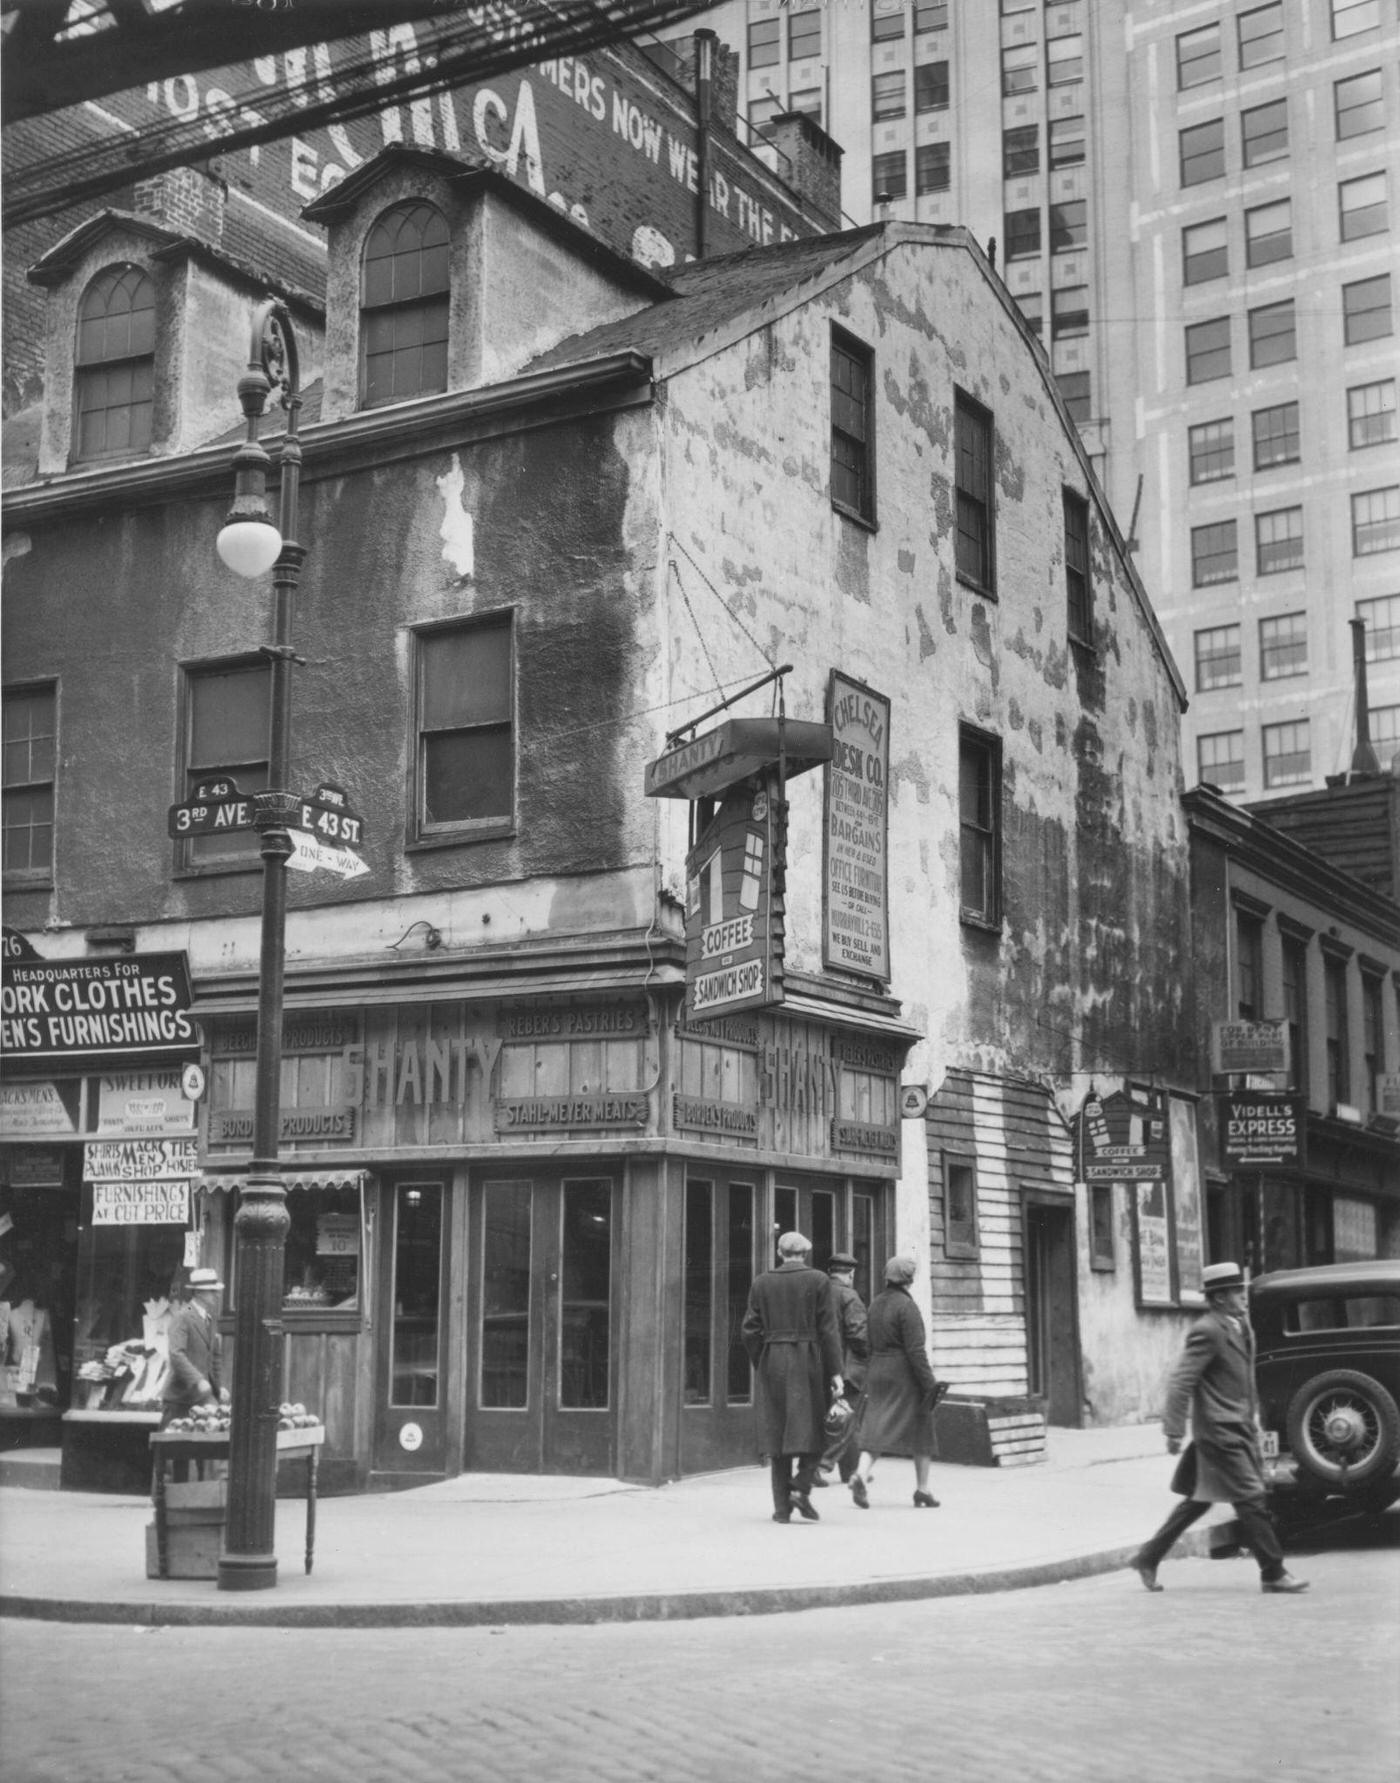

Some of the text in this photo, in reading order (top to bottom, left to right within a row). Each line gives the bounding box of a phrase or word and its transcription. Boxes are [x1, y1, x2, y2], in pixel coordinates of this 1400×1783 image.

[611, 90, 662, 164] NOW
[834, 694, 884, 750] CHELSEA
[832, 738, 864, 780] DESK
[199, 783, 228, 798] E 43
[176, 807, 207, 830] 3RD
[302, 807, 313, 829] E
[318, 811, 338, 836] 43
[831, 812, 882, 854] BARGAINS
[336, 855, 359, 871] WAY
[831, 880, 841, 894] SEE
[706, 920, 749, 954] COFFEE
[832, 932, 841, 944] WE
[853, 938, 869, 953] SELL
[870, 943, 881, 957] AND
[2, 976, 177, 1014] ORK CLOTHES
[699, 964, 760, 1004] SANDWICH SHOP
[2, 1009, 192, 1048] EN'S FURNISHINGS
[567, 1010, 635, 1033] PASTRIES
[283, 1024, 344, 1050] PRODUCTS
[342, 1037, 503, 1105] SHANTY
[507, 1101, 638, 1124] STAHL-MEYER MEATS
[281, 1114, 344, 1136] PRODUCTS
[1228, 1119, 1296, 1136] EXPRESS
[87, 1143, 121, 1161] SHIRTS
[169, 1140, 198, 1158] TIES
[1102, 1148, 1138, 1156] COFFEE
[121, 1163, 163, 1178] SHOP
[1091, 1166, 1158, 1177] SANDWICH SHOP
[96, 1184, 185, 1204] FURNISHINGS
[114, 1205, 137, 1222] CUT
[144, 1203, 185, 1221] PRICE
